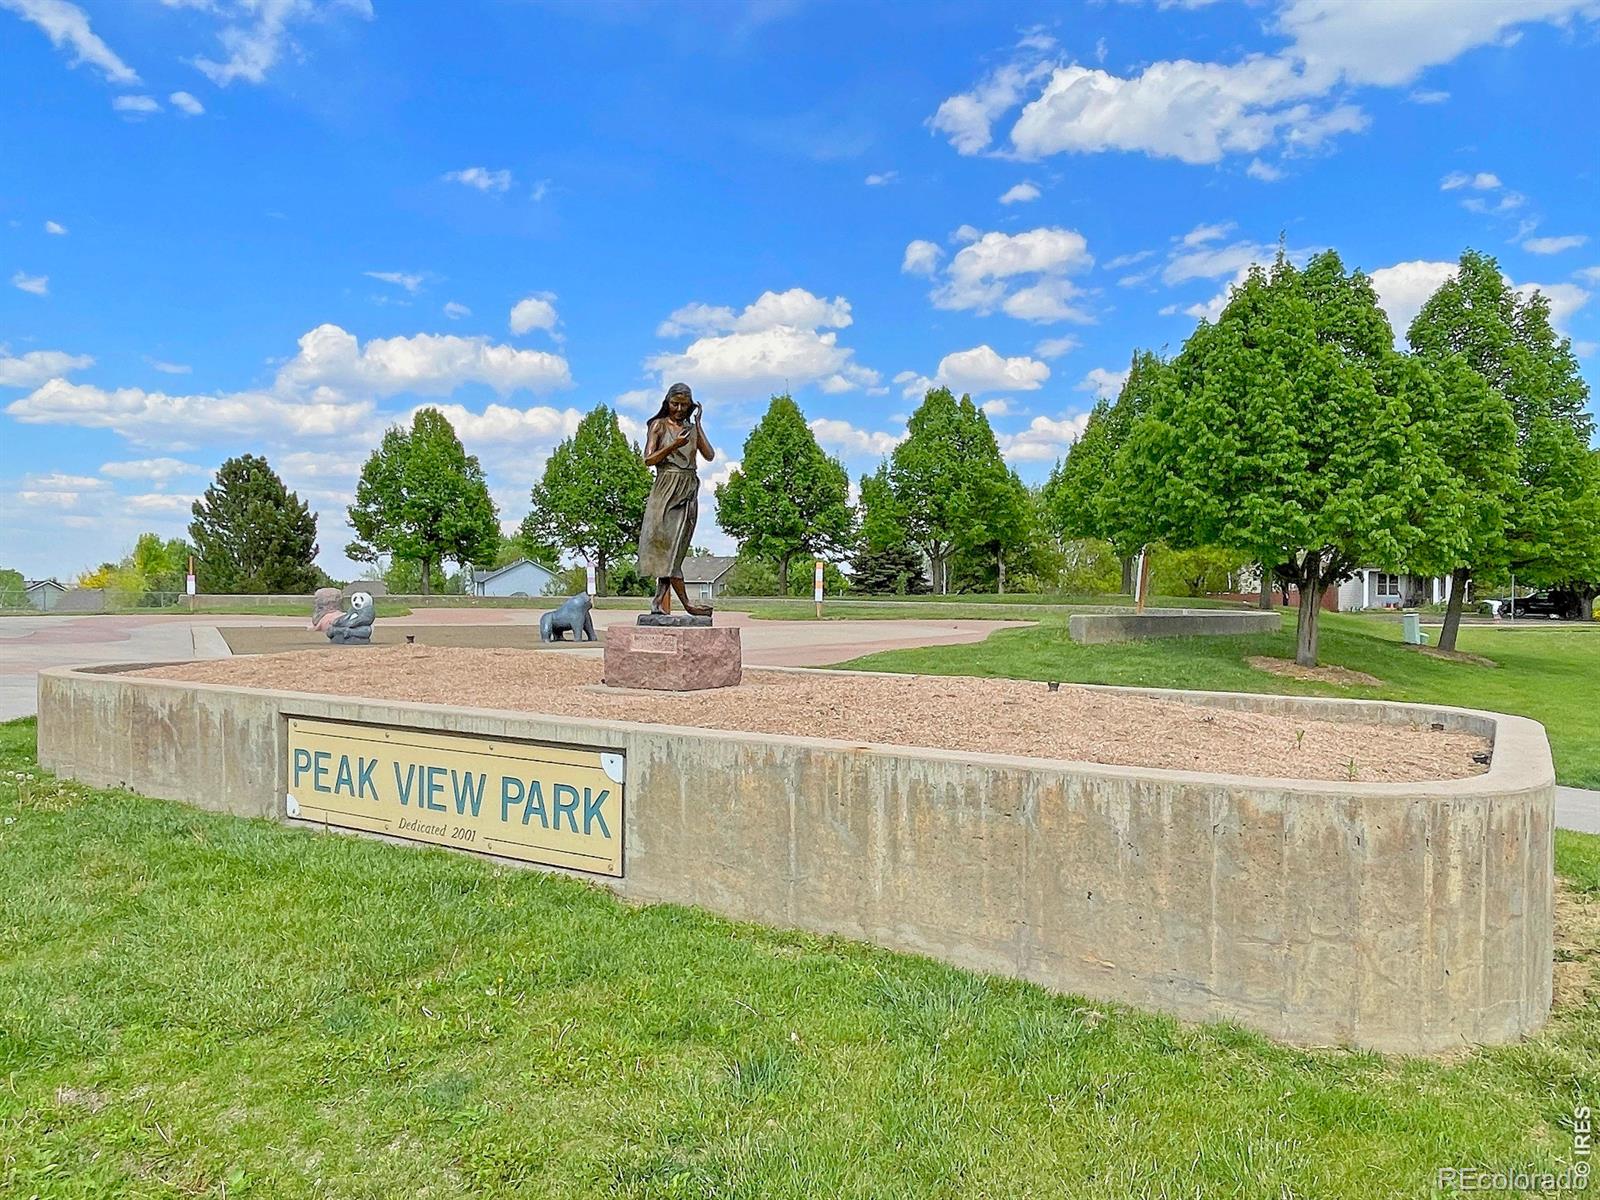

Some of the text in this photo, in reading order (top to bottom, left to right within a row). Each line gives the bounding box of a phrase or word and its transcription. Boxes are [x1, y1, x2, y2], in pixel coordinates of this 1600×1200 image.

[293, 748, 613, 839] PEAK VIEW PARK
[398, 817, 477, 842] Dedicated 2001
